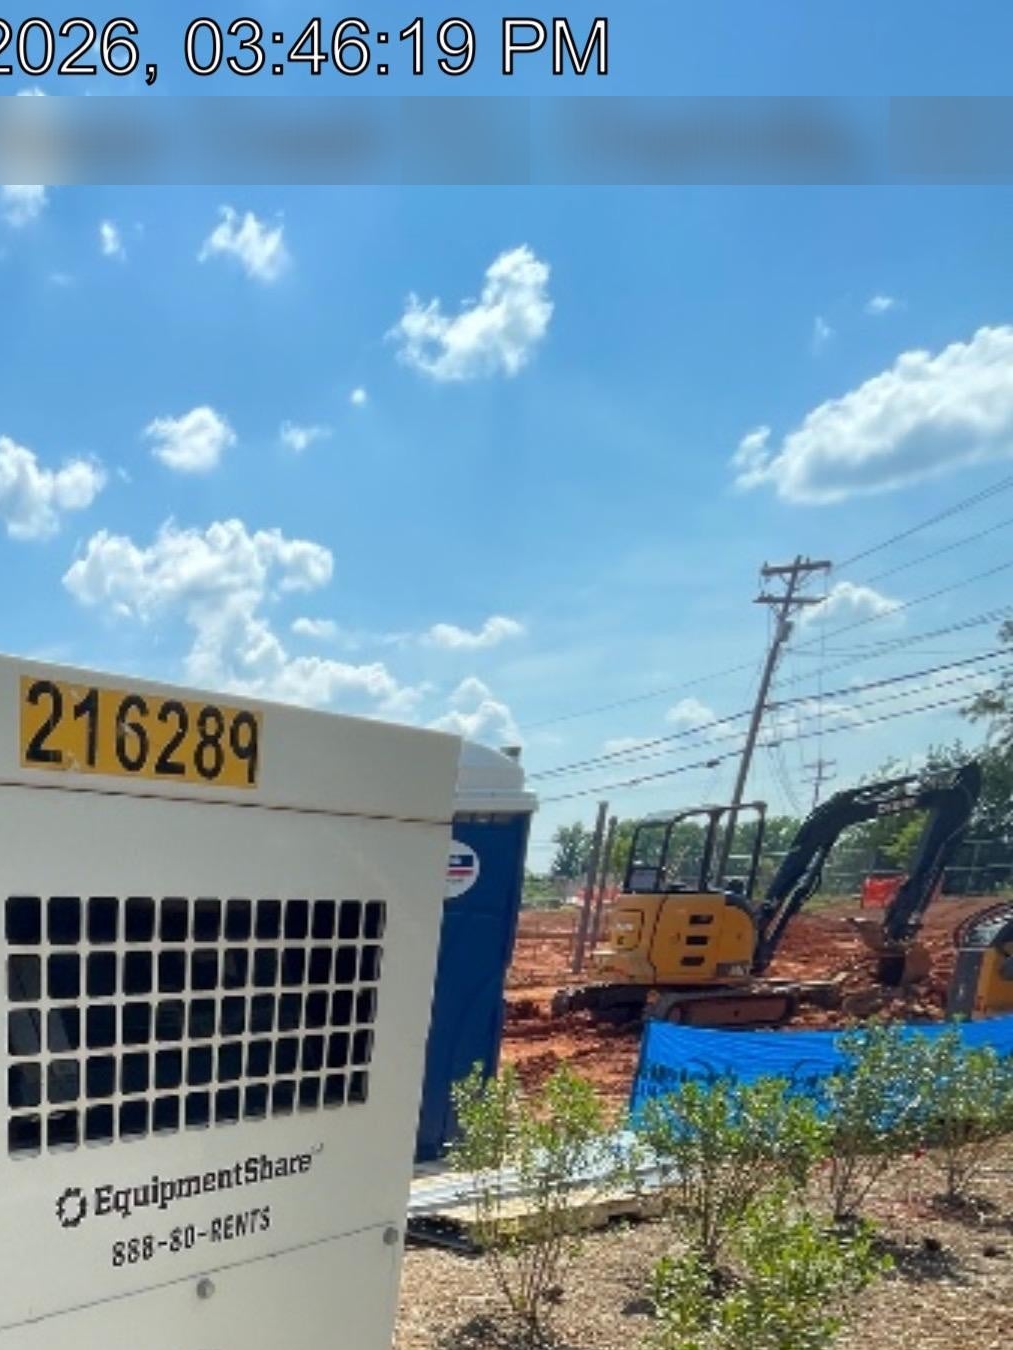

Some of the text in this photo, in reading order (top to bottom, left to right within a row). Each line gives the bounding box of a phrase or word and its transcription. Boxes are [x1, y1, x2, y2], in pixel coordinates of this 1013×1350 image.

[25, 680, 259, 784] 216289
[94, 1151, 312, 1217] EquipmentShare
[112, 1206, 271, 1266] 888-80-RENTS
